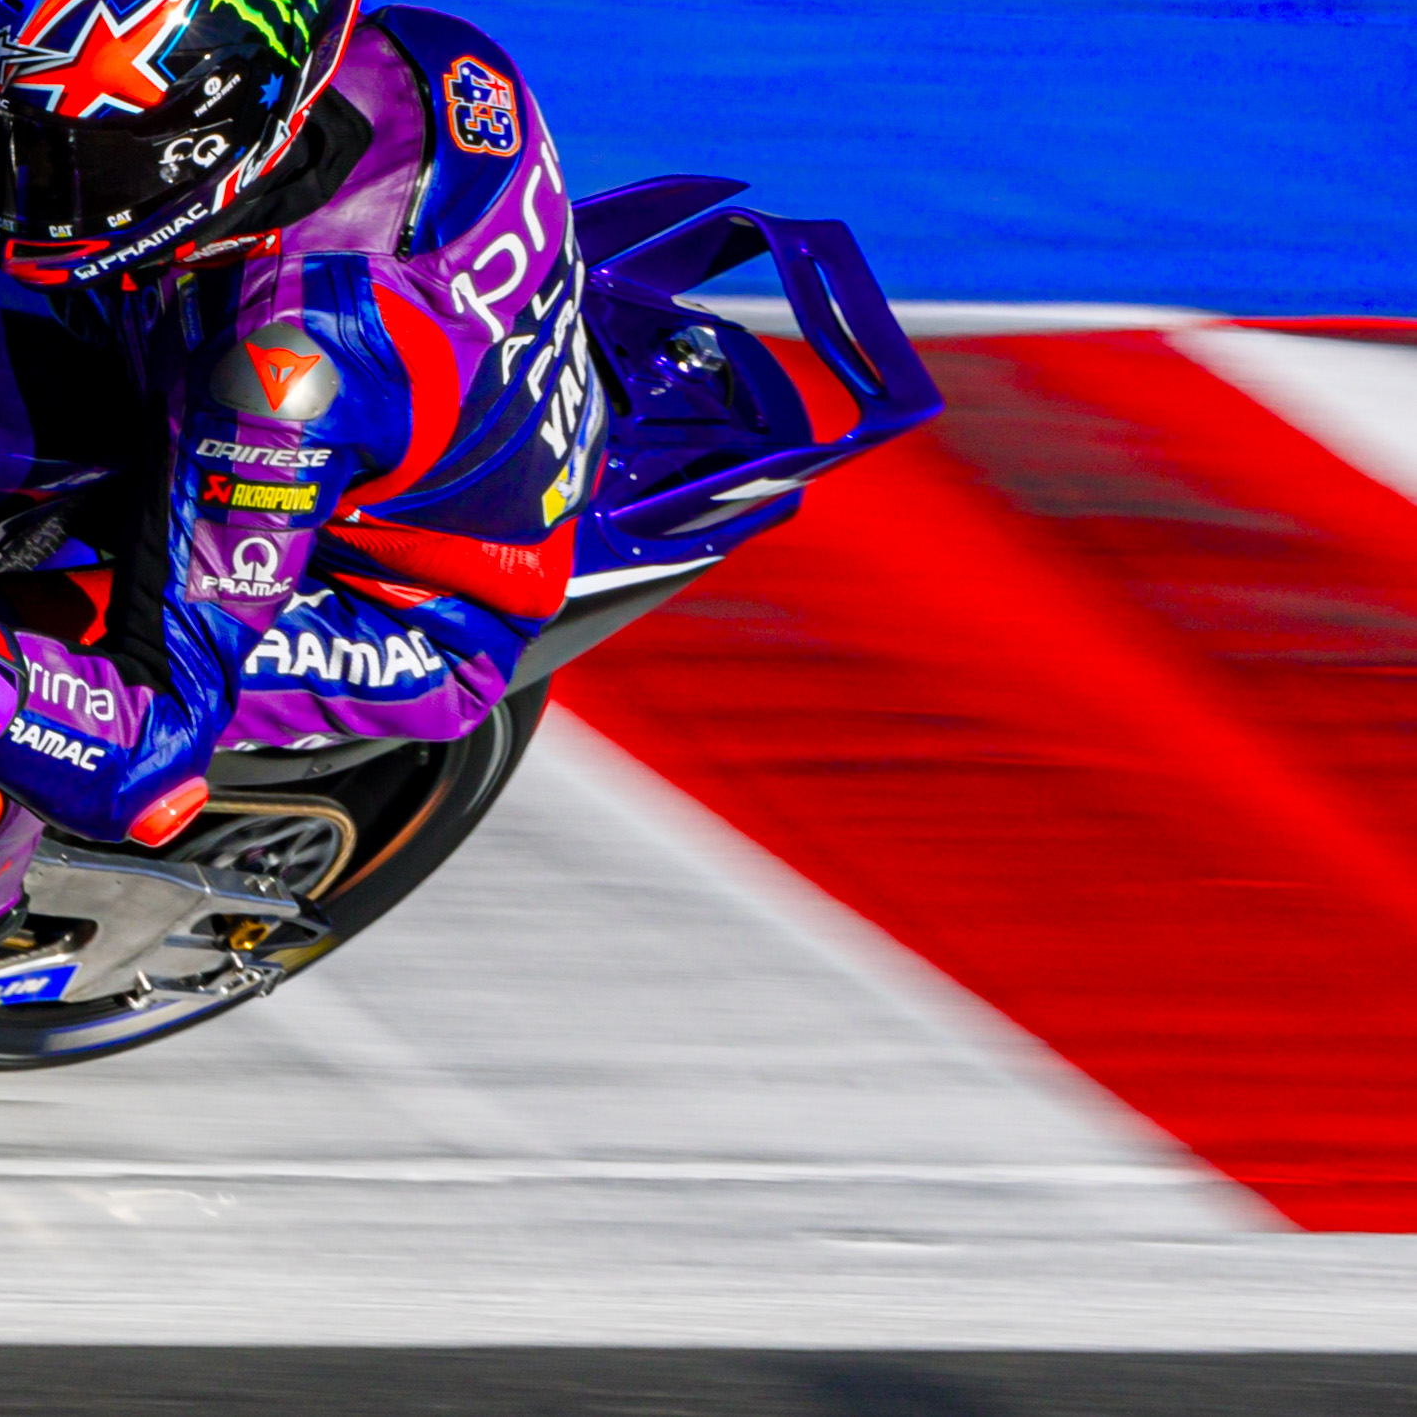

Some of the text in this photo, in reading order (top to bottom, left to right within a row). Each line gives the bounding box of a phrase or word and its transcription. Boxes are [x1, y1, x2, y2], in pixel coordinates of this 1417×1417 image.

[444, 55, 521, 157] 43
[48, 224, 73, 238] CAT
[97, 202, 208, 271] PRAMAC
[106, 209, 133, 228] CAT
[196, 438, 333, 469] DAINESE
[201, 574, 293, 597] PRAMAC
[245, 628, 444, 688] RAMAC
[23, 655, 115, 721] rima
[9, 716, 106, 772] RAMAC
